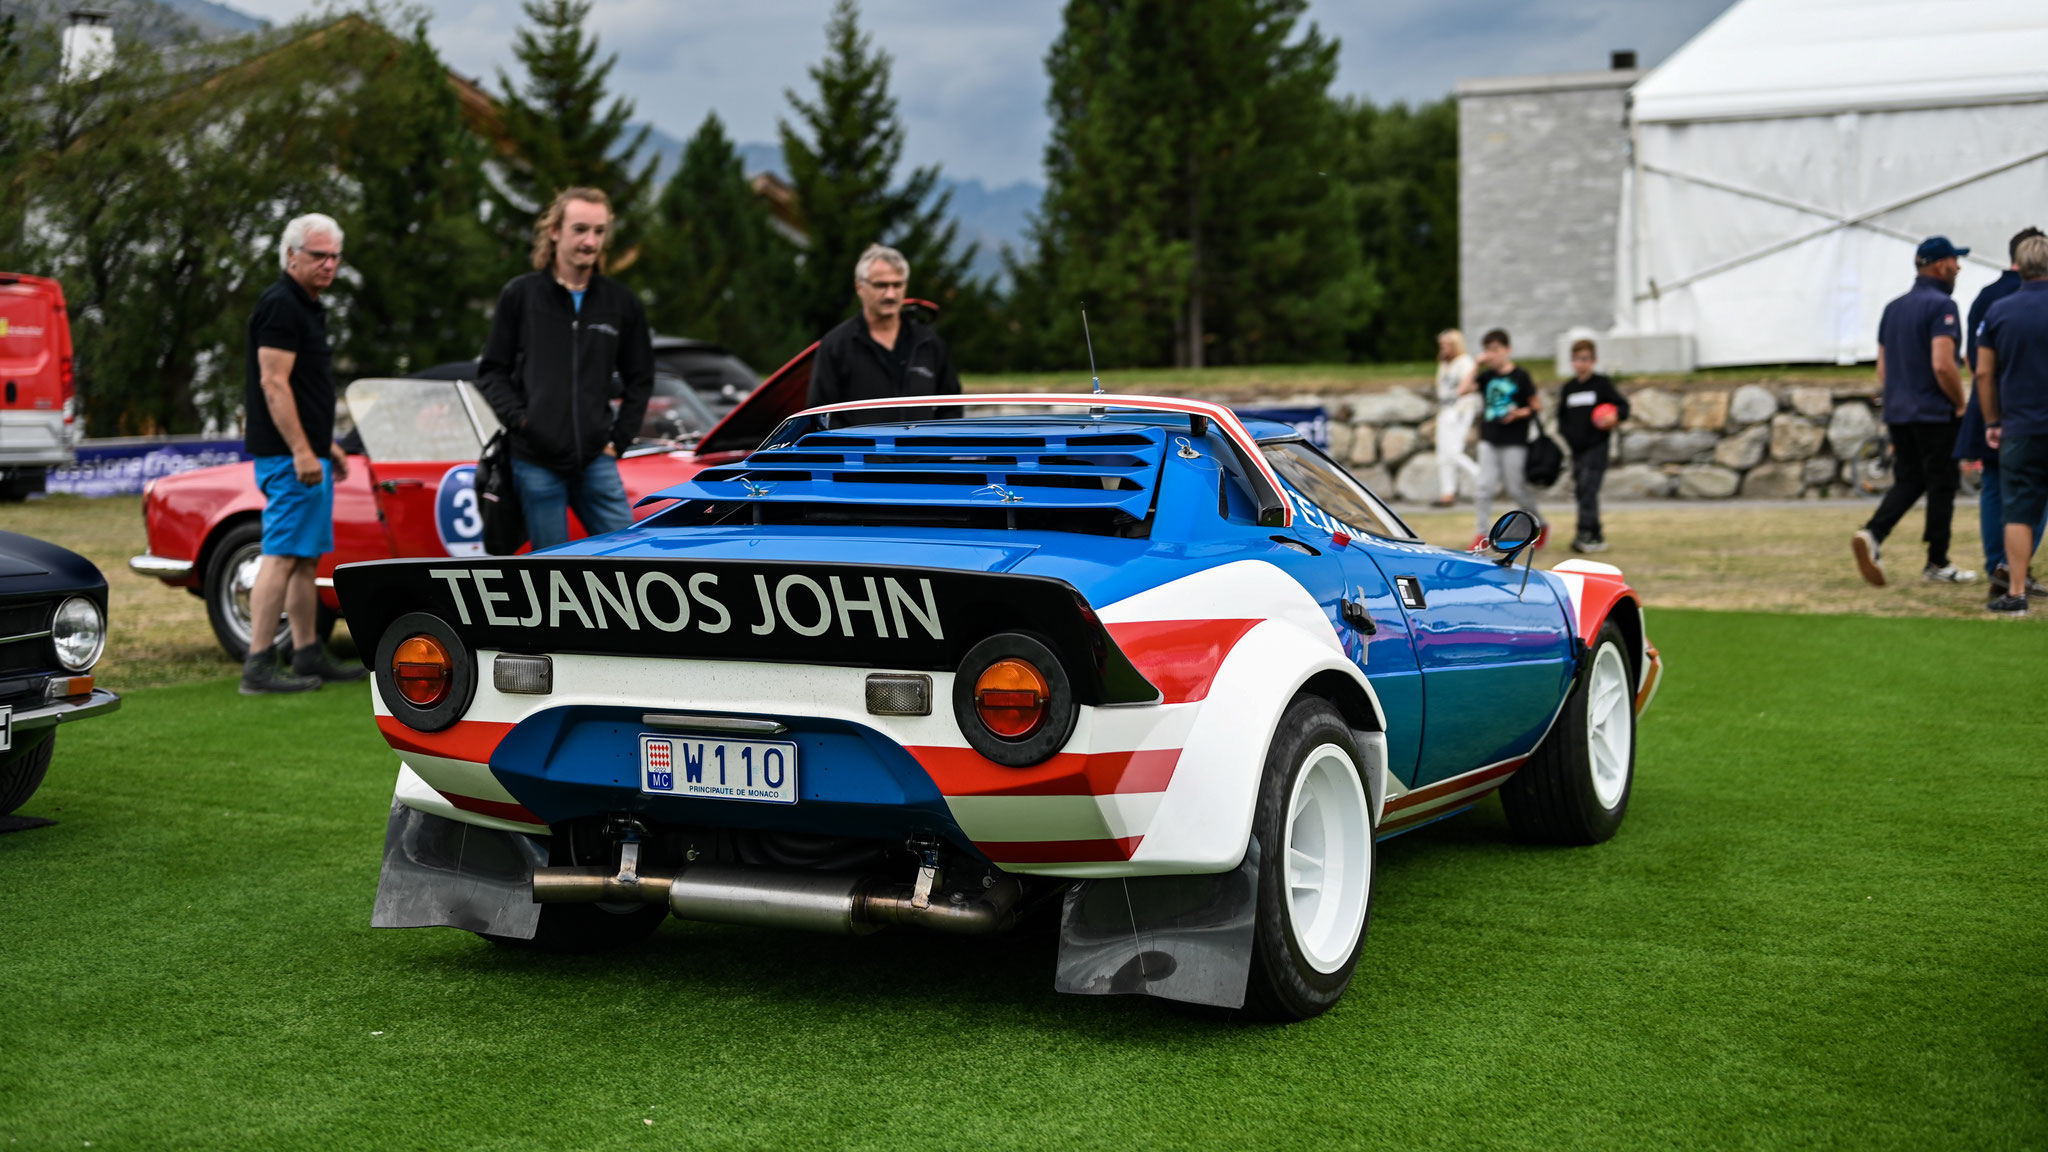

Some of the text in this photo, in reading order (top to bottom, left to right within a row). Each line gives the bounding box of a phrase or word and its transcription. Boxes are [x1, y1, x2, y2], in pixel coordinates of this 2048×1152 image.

[429, 569, 944, 640] TEJANOS JOHN
[652, 773, 669, 787] MC
[683, 742, 784, 788] W110
[689, 785, 779, 798] PRINCIPAUTE DE MONACO
